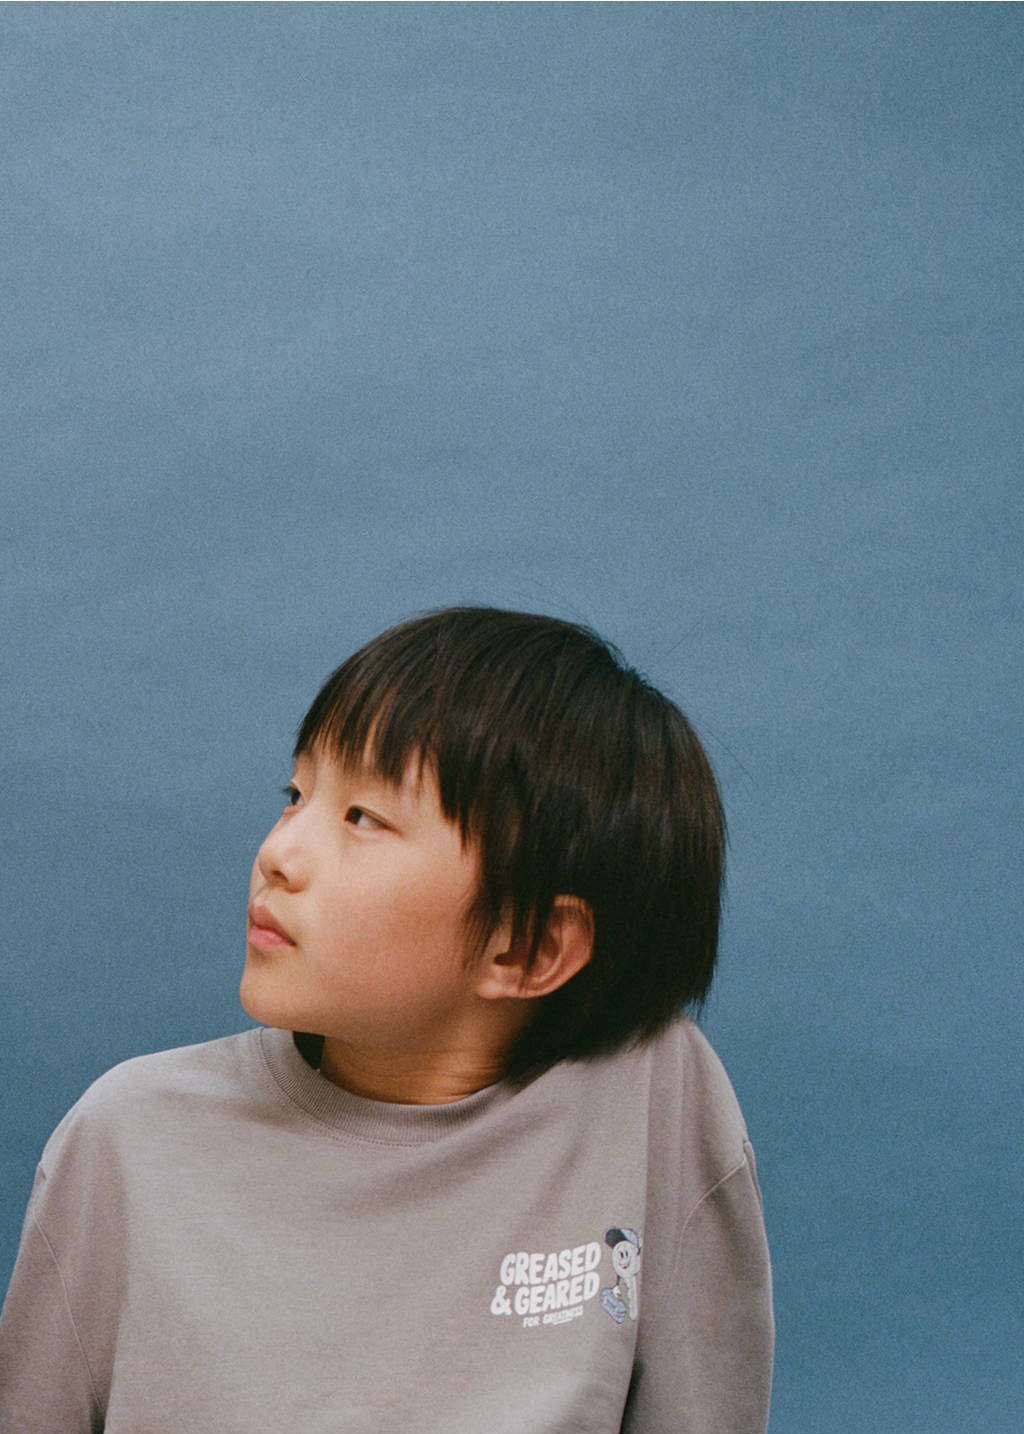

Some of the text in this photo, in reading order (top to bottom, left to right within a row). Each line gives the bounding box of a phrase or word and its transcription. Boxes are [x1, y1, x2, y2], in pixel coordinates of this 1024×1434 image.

[500, 1241, 602, 1286] GREASED
[490, 1271, 601, 1316] & GEARED
[523, 1316, 541, 1328] FOR
